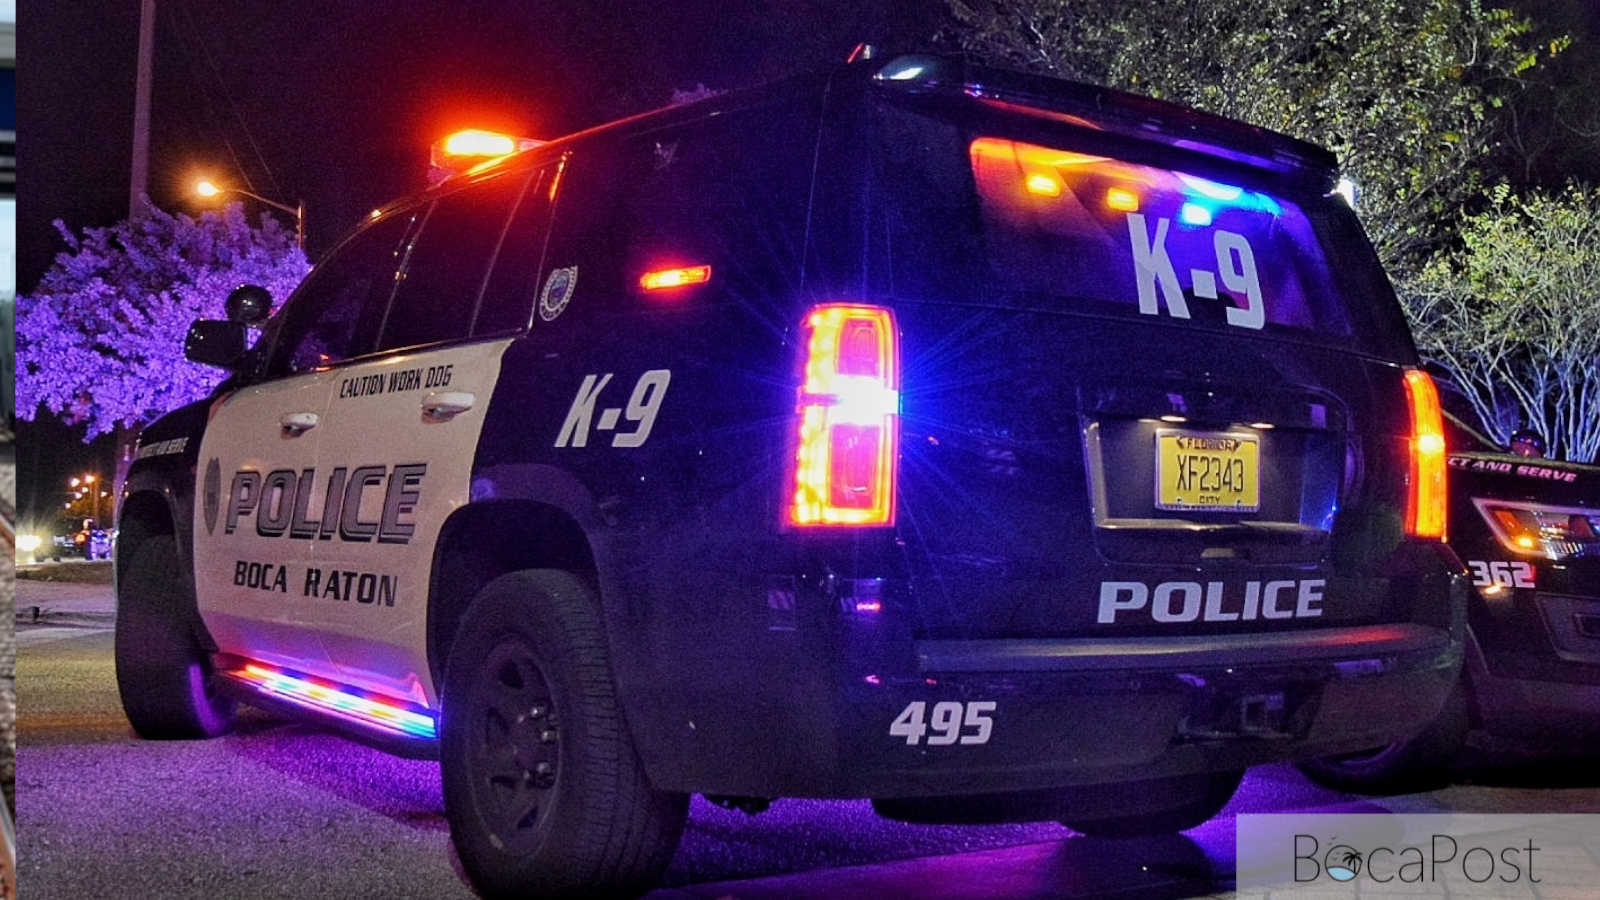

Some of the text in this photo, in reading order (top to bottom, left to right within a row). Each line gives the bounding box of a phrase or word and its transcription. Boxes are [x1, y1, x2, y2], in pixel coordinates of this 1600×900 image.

[1126, 212, 1265, 330] K-9
[340, 364, 454, 399] CAUTION WORK DOG
[554, 369, 671, 448] K-9
[1176, 454, 1244, 493] XF2343
[1472, 460, 1511, 473] AND
[1516, 465, 1577, 483] SERVE
[225, 463, 427, 544] POLICE
[1199, 495, 1221, 505] CITY
[233, 560, 398, 607] BOCA RATON
[1468, 560, 1536, 588] 362
[1097, 579, 1326, 624] POLICE
[889, 701, 997, 745] 495
